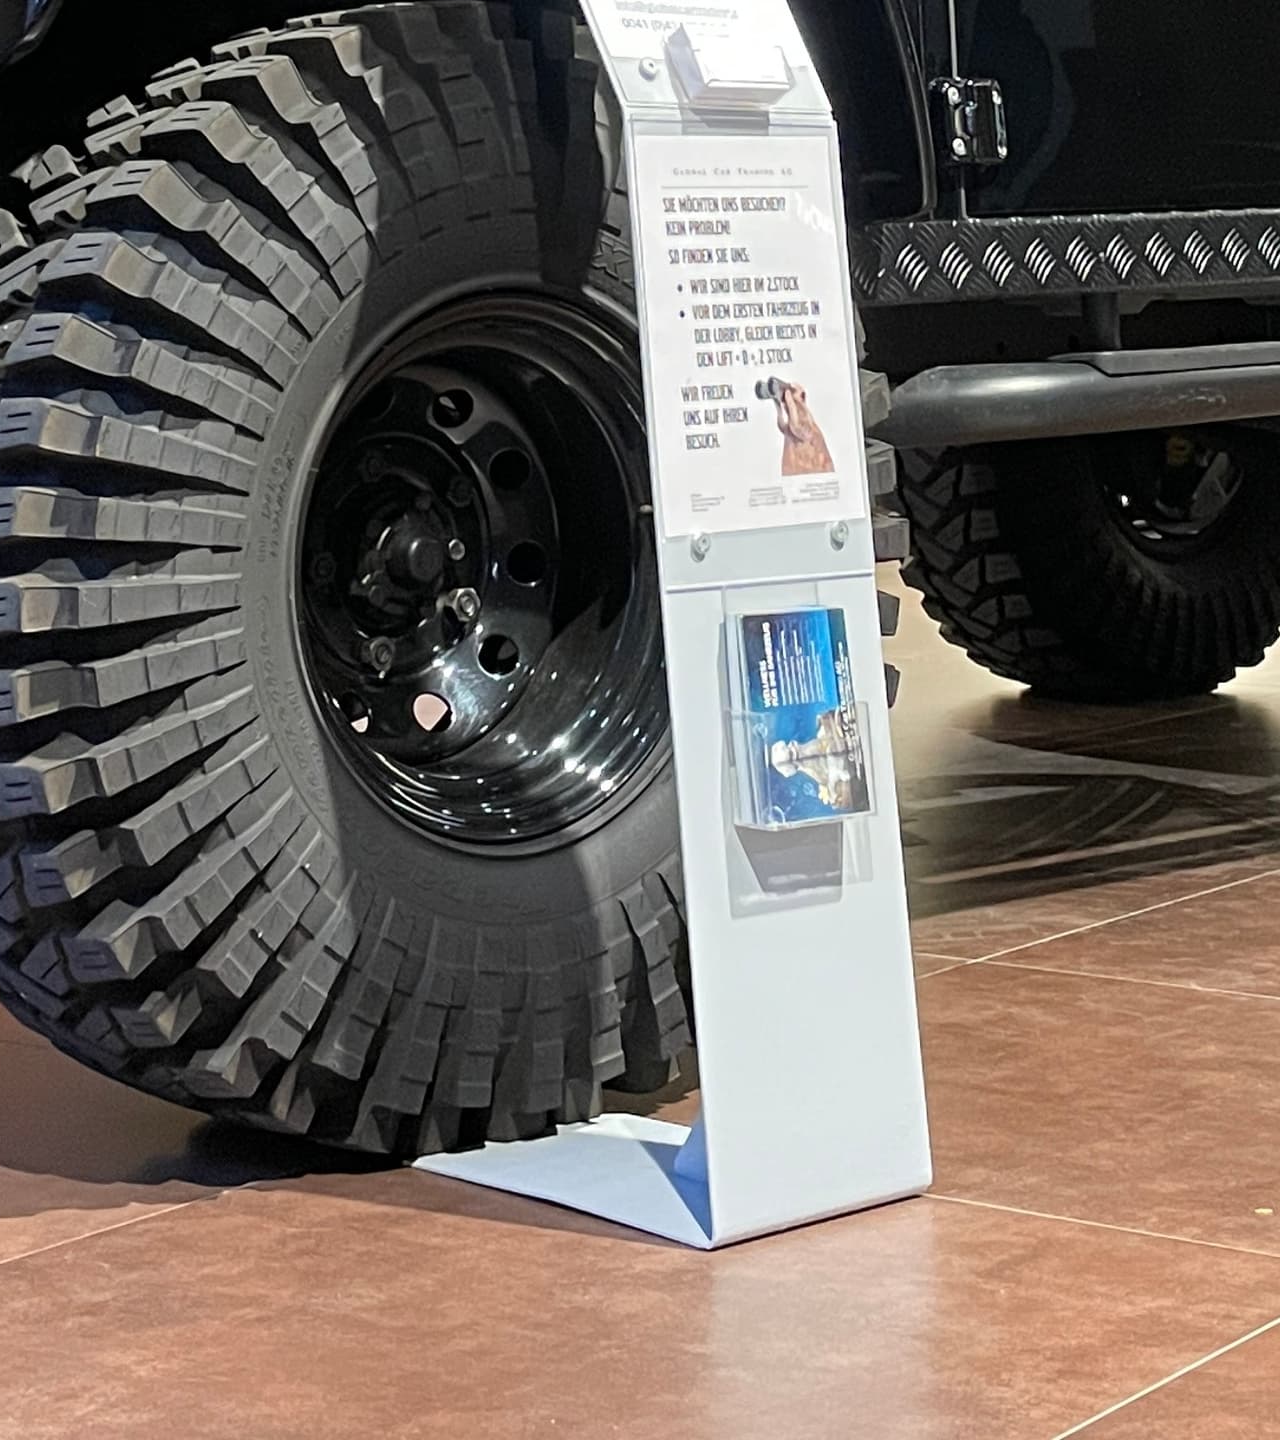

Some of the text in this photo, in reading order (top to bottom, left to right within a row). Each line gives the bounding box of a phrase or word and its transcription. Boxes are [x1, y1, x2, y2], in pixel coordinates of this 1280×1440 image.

[662, 197, 677, 213] SIE
[678, 195, 719, 213] MÖCHTEN
[721, 196, 739, 212] UNS
[665, 220, 687, 236] KEIN
[668, 249, 680, 265] SO
[682, 248, 714, 264] FINDEN
[715, 248, 729, 264] SIE
[689, 279, 709, 294] WIR
[710, 278, 730, 294] SIND
[732, 277, 752, 293] HIER
[691, 304, 711, 320] VOR
[712, 304, 731, 320] DEM
[733, 302, 764, 319] ERSTEN
[766, 301, 809, 317] FAHRZEUG
[694, 328, 712, 344] DER
[744, 325, 774, 341] GLEICH
[775, 324, 806, 340] RECHTS
[696, 351, 714, 368] DEN
[715, 350, 733, 367] LIFT
[766, 348, 793, 364] STOCK
[680, 384, 734, 402] WIR FREUEN
[683, 406, 749, 426] UNS AUF IHREN
